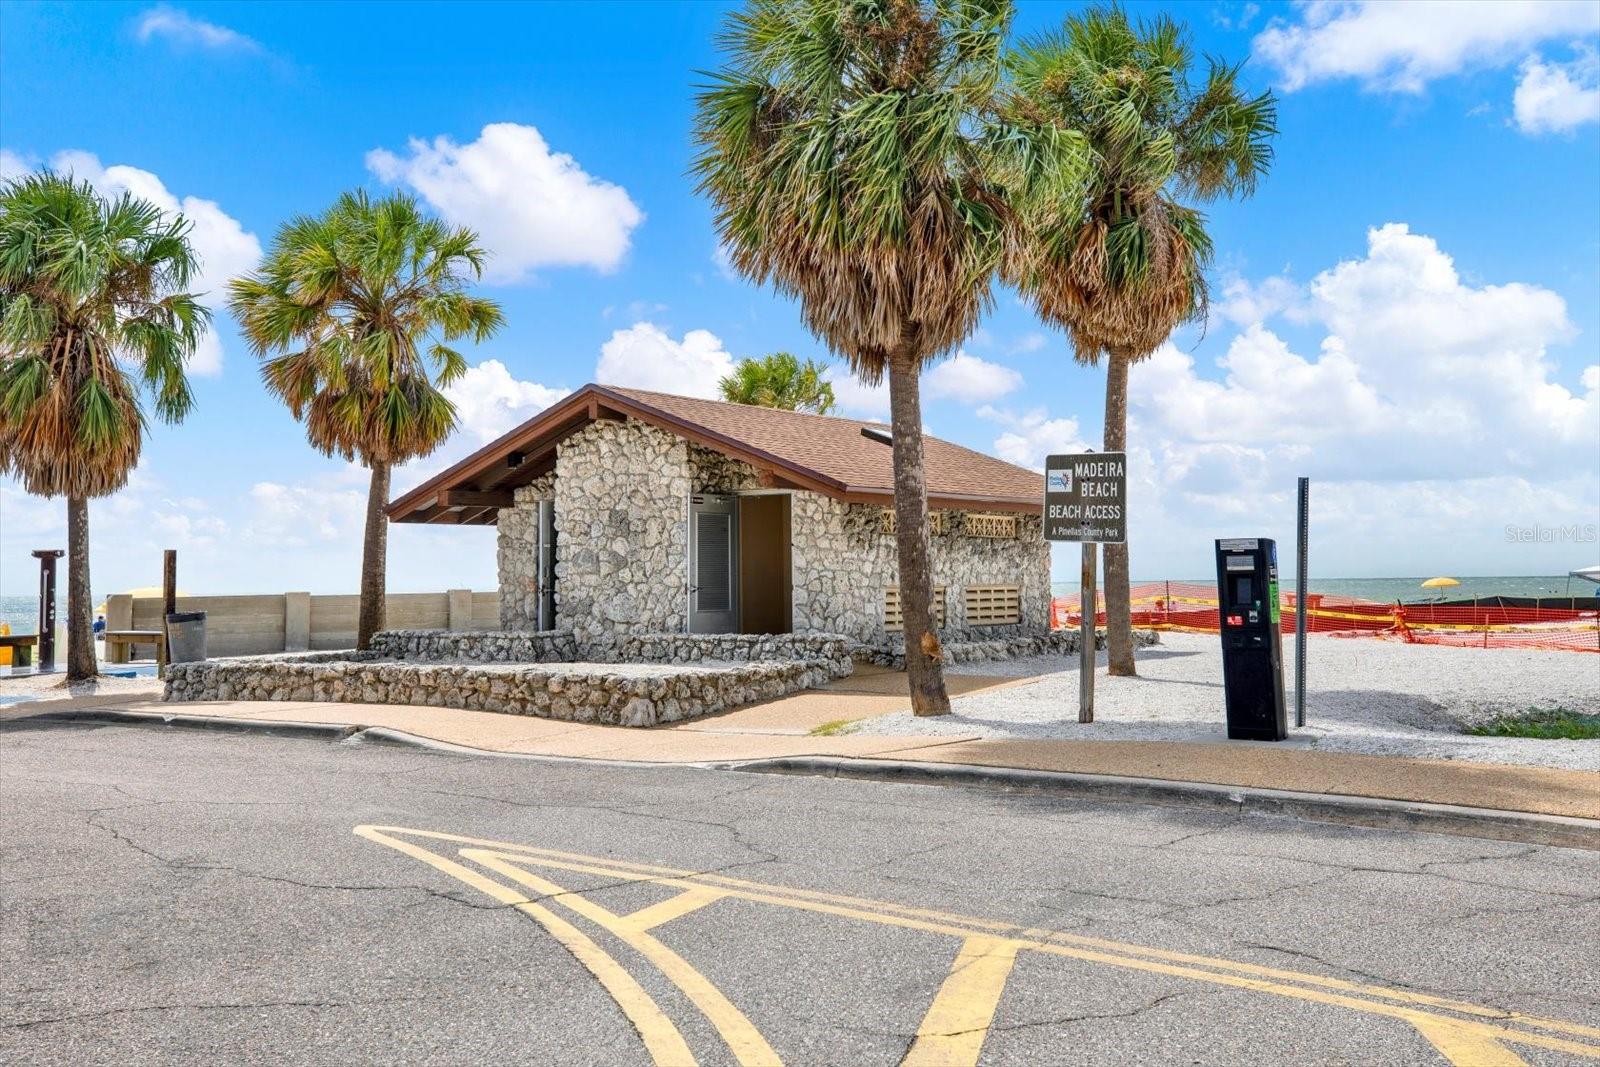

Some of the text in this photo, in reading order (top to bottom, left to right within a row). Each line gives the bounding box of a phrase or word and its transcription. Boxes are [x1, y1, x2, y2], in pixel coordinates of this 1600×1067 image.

[1075, 462, 1123, 477] MADEIRA
[1081, 482, 1117, 497] BEACH
[1049, 505, 1120, 519] BEACH ACCESS
[1052, 527, 1057, 536] A
[1084, 528, 1103, 538] County
[1105, 528, 1118, 537] Park
